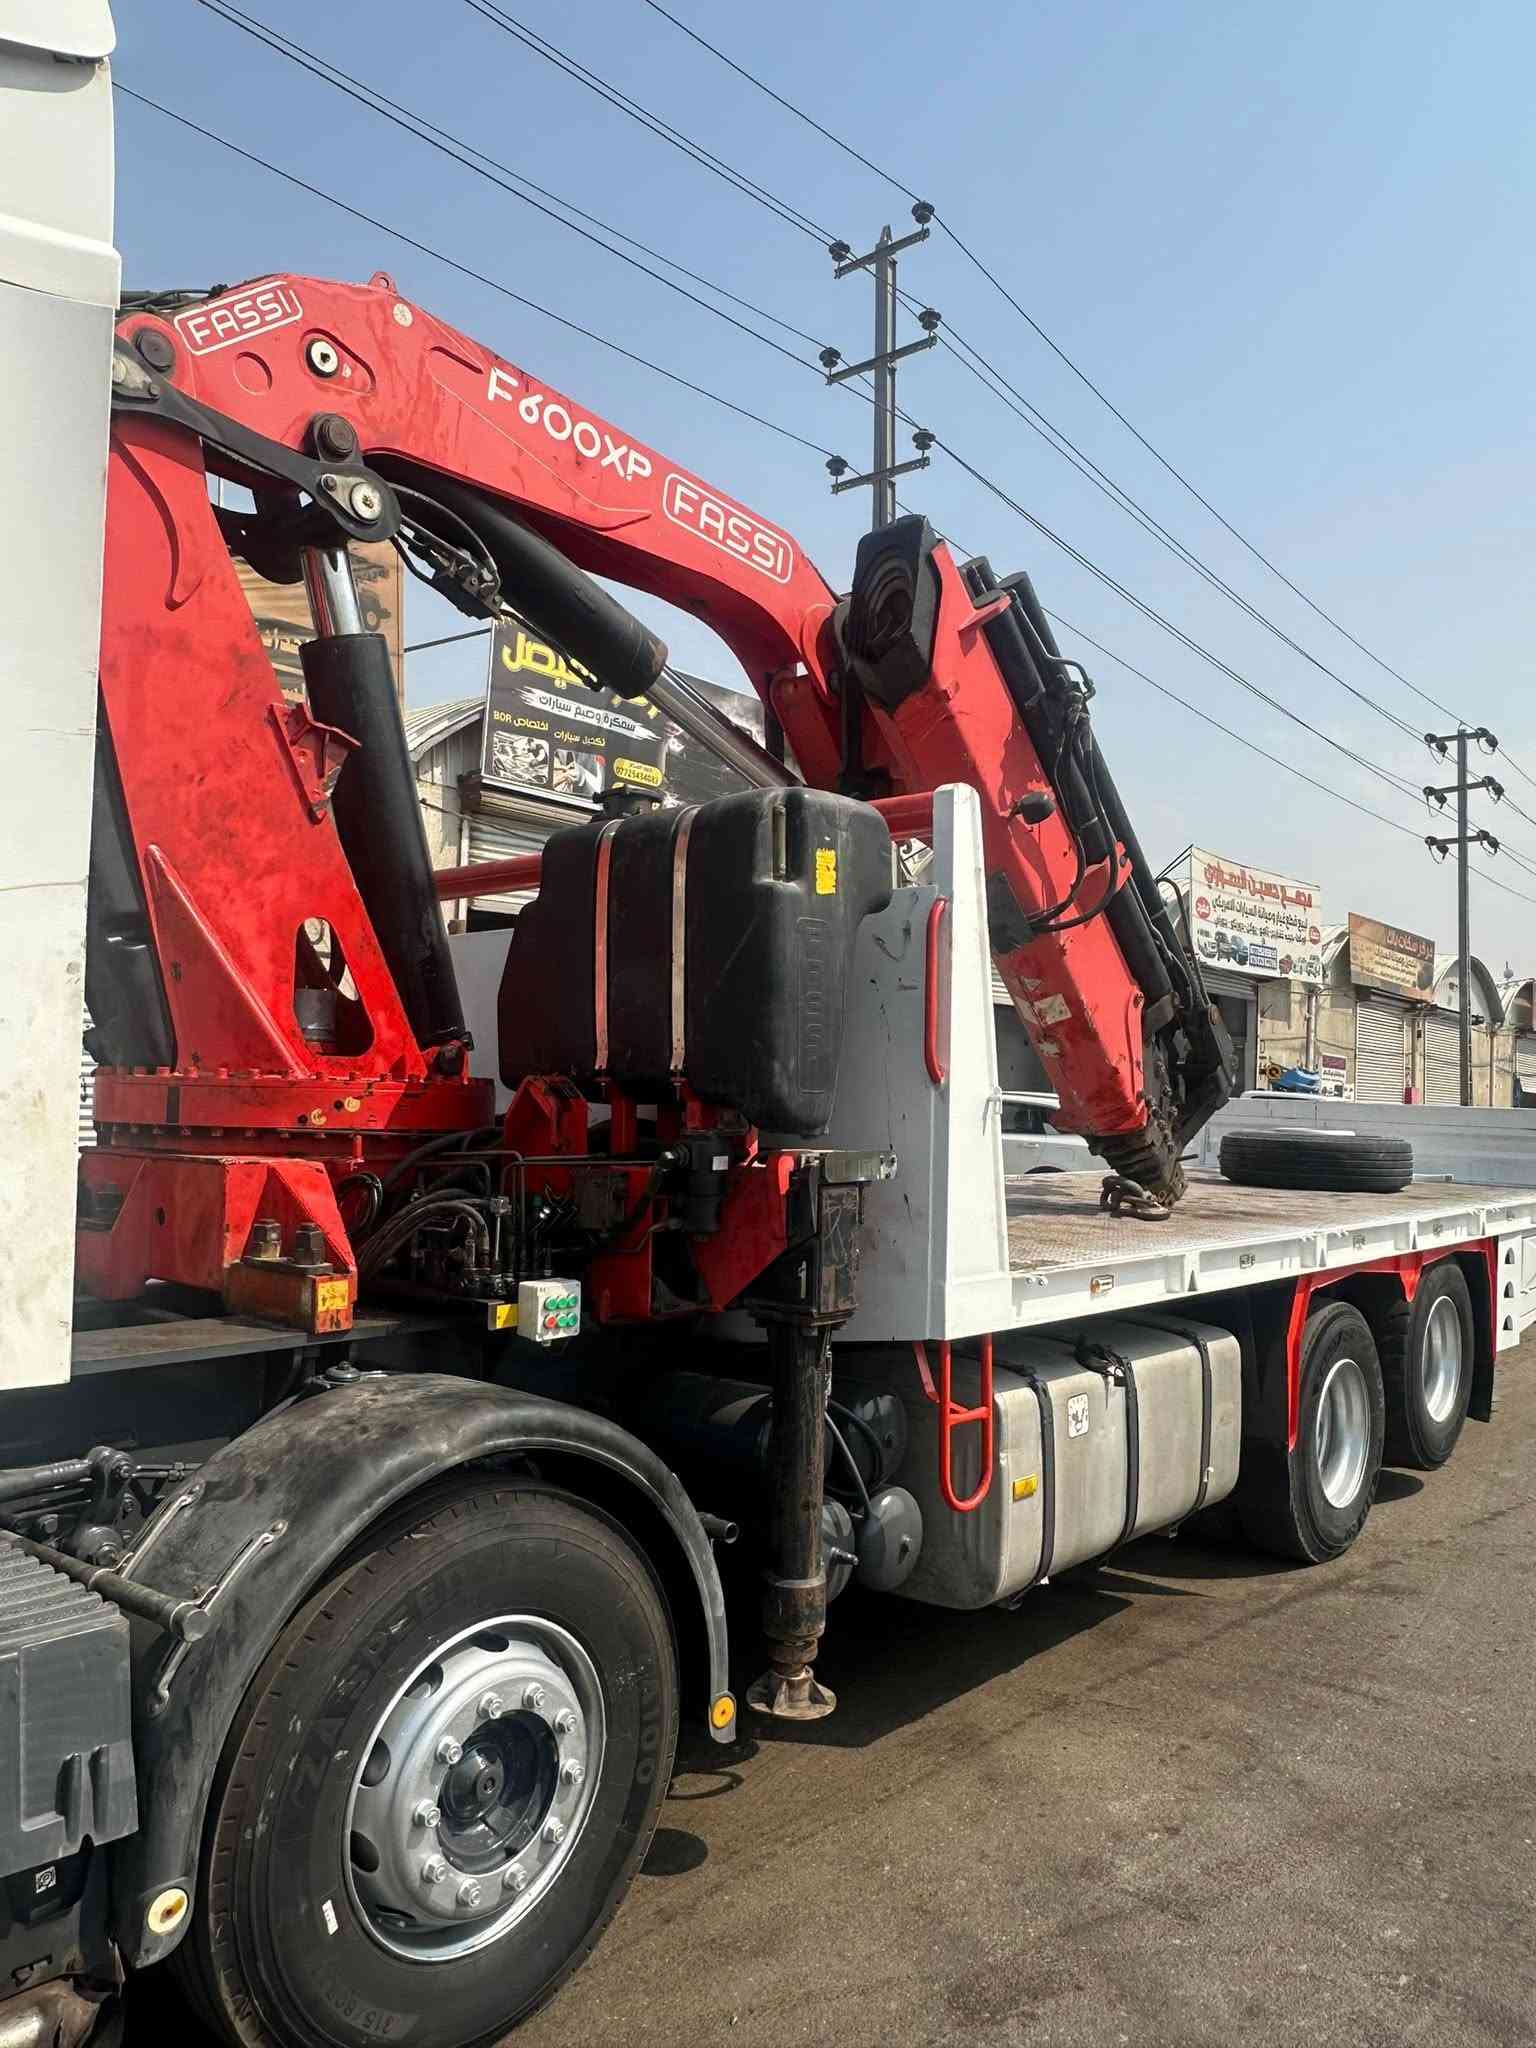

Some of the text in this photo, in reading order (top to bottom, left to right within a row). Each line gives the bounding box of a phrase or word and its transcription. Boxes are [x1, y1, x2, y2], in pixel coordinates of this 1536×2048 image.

[186, 289, 291, 345] FASSI
[673, 483, 784, 575] FASSI
[539, 695, 572, 714] سيارات
[513, 717, 549, 731] اختصاص
[603, 712, 637, 733] سمكرة
[554, 730, 581, 743] سيارات
